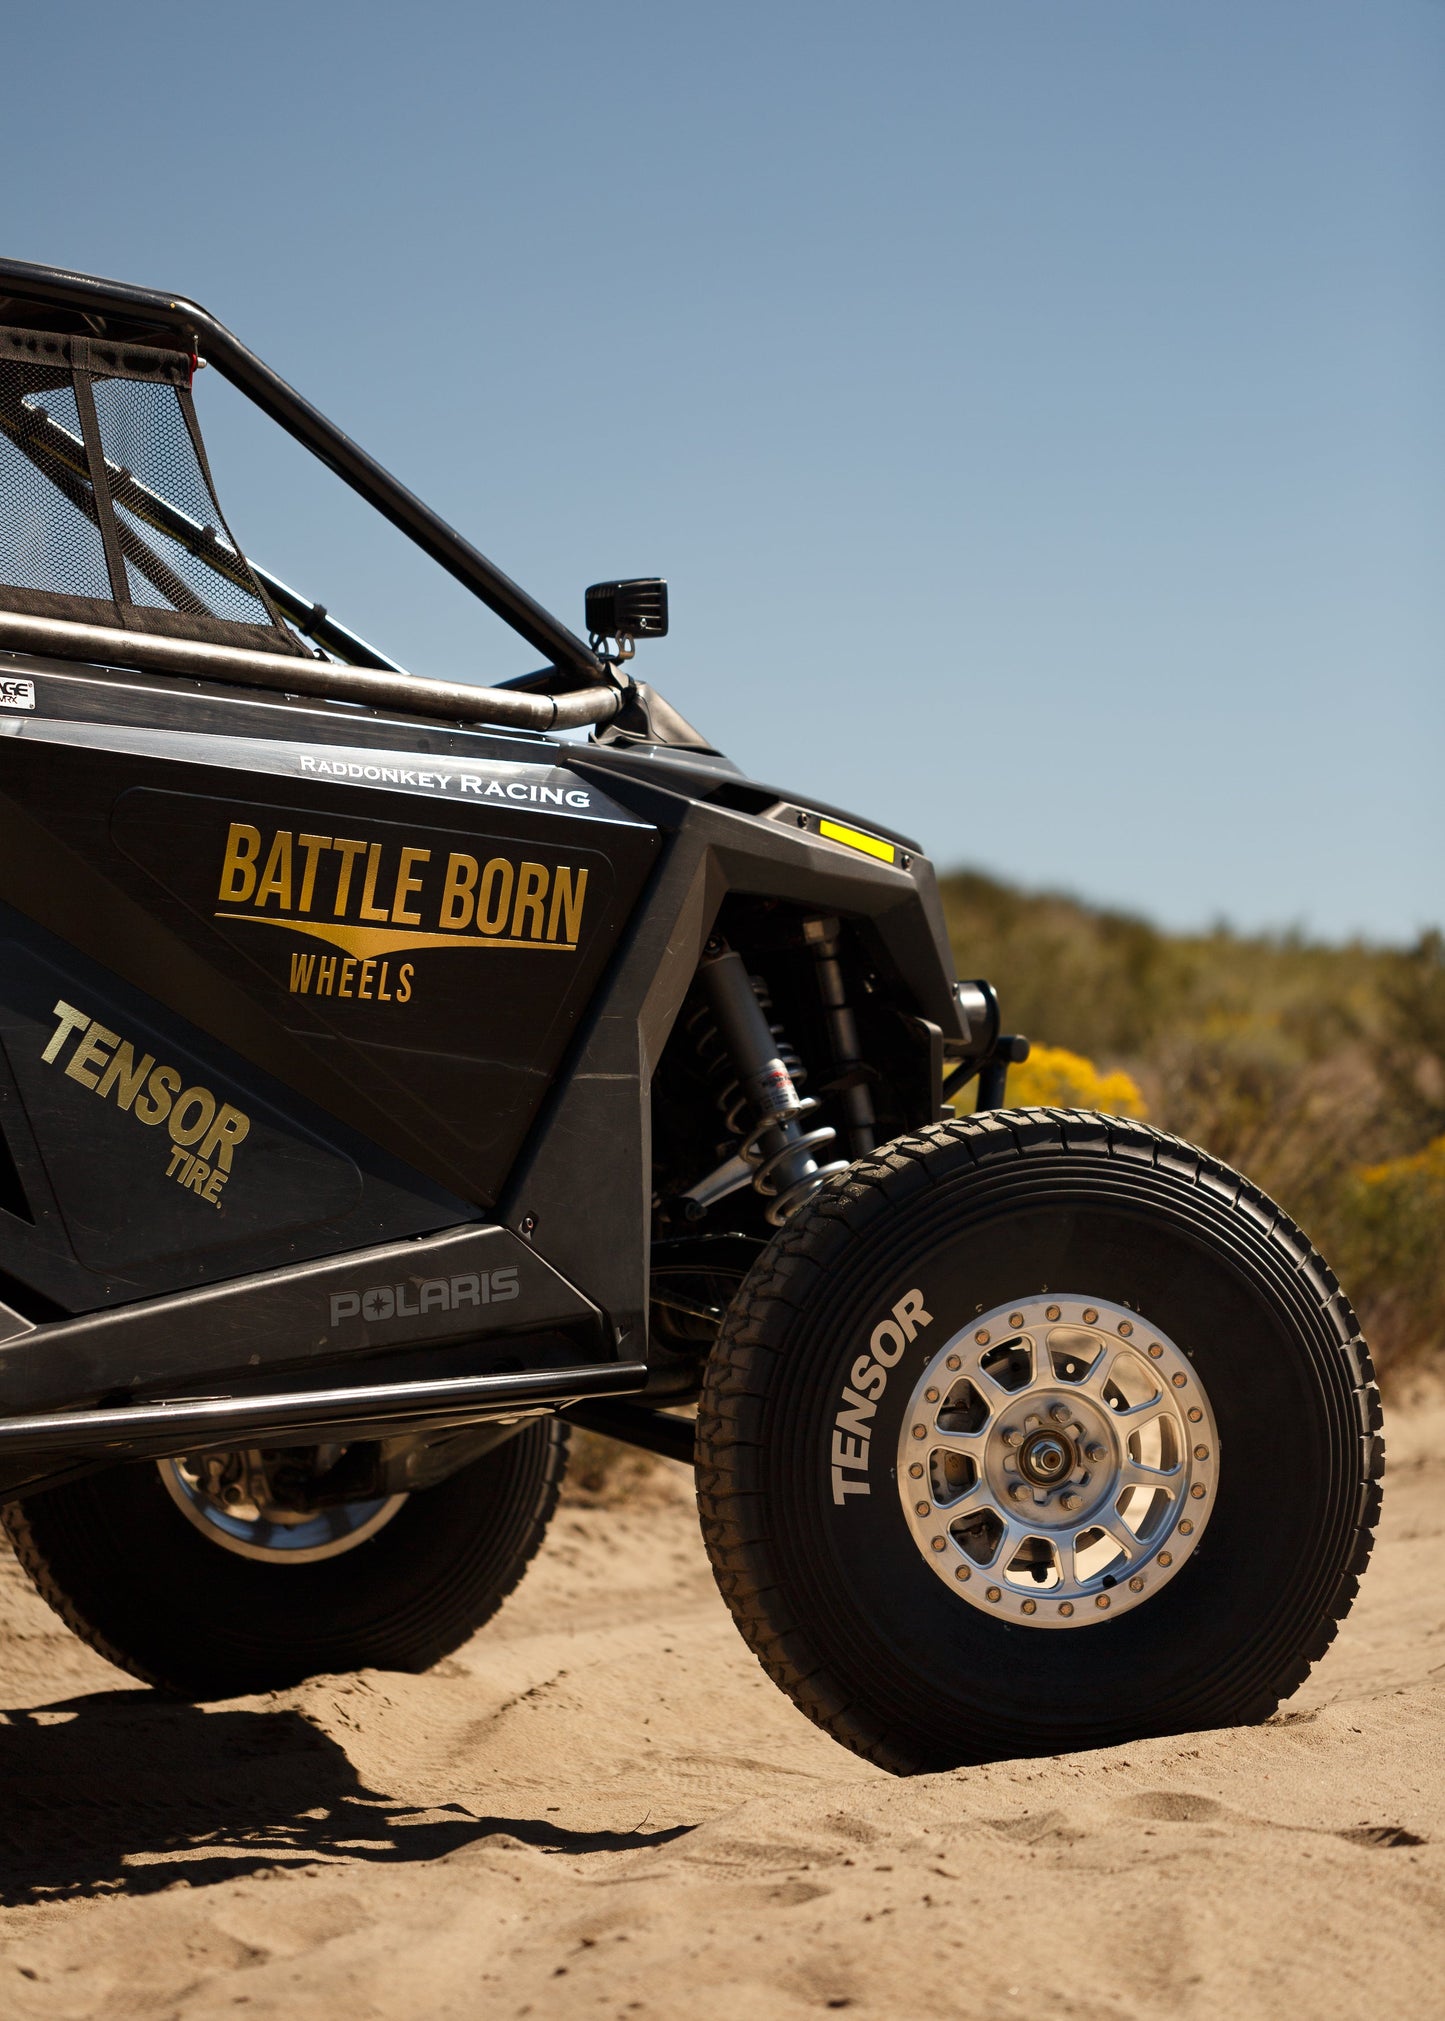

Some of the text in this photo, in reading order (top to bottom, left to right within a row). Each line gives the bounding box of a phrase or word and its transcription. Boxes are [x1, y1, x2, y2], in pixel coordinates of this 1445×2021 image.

[460, 774, 591, 808] RACING
[219, 823, 589, 943] BATTLE BORN
[290, 953, 414, 1003] WHEELS
[41, 999, 250, 1173] TENSOR
[331, 1267, 521, 1327] POLARIS
[831, 1288, 934, 1505] TENSOR
